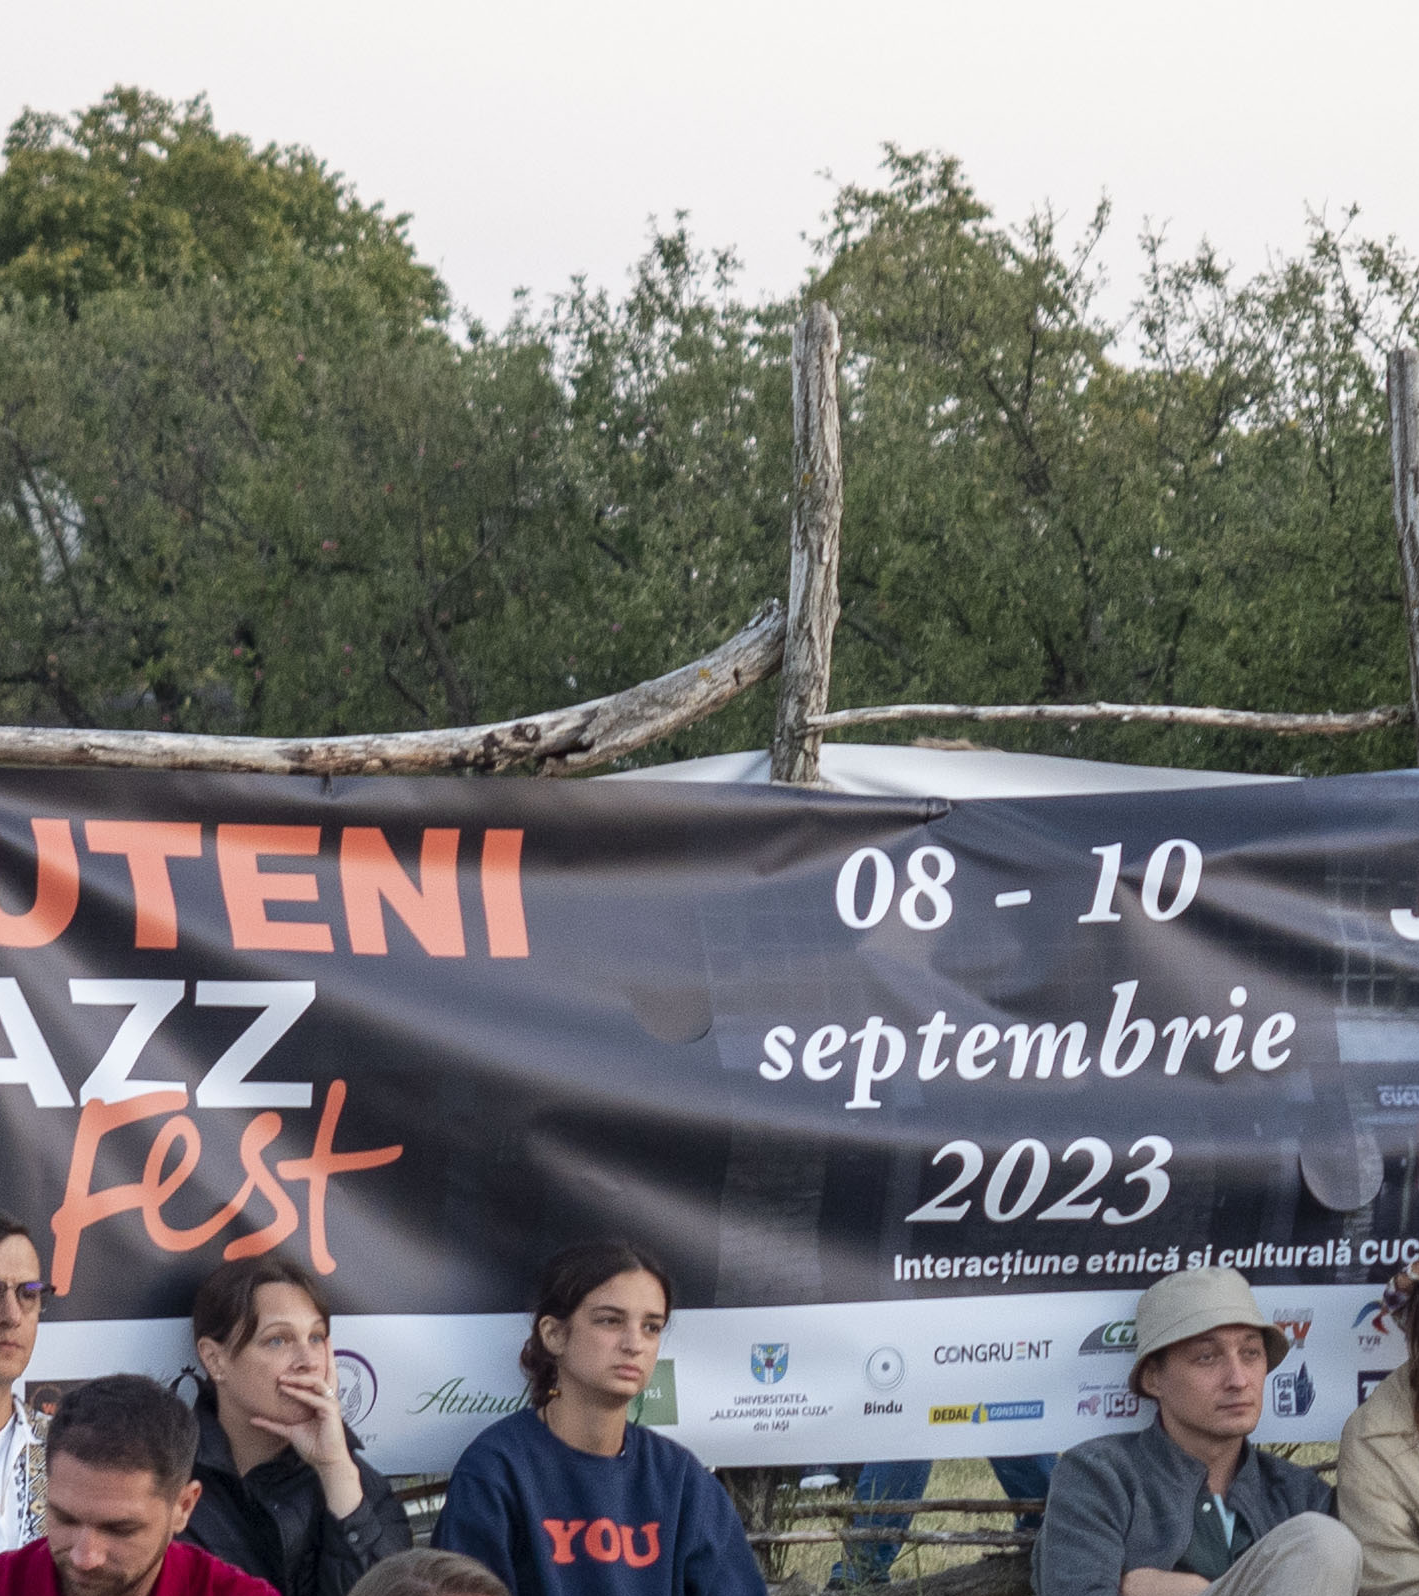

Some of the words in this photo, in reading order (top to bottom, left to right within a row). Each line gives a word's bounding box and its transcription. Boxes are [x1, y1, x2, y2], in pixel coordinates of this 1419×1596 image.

[836, 846, 956, 930] 08
[1078, 838, 1203, 924] 10
[759, 980, 1296, 1109] septembrie
[51, 1079, 403, 1296] Fest
[905, 1135, 1173, 1226] 2023
[894, 1249, 1079, 1284] Interacțiune
[1086, 1245, 1180, 1274] etnică
[1218, 1238, 1350, 1269] culturală
[933, 1339, 1053, 1365] CONGRUENT
[734, 1393, 808, 1406] UNIVERSITATEA
[775, 1407, 799, 1418] IOAN
[863, 1401, 903, 1415] Bindu
[932, 1409, 970, 1423] DEDAL
[753, 1420, 770, 1432] din
[542, 1517, 660, 1568] YOU
